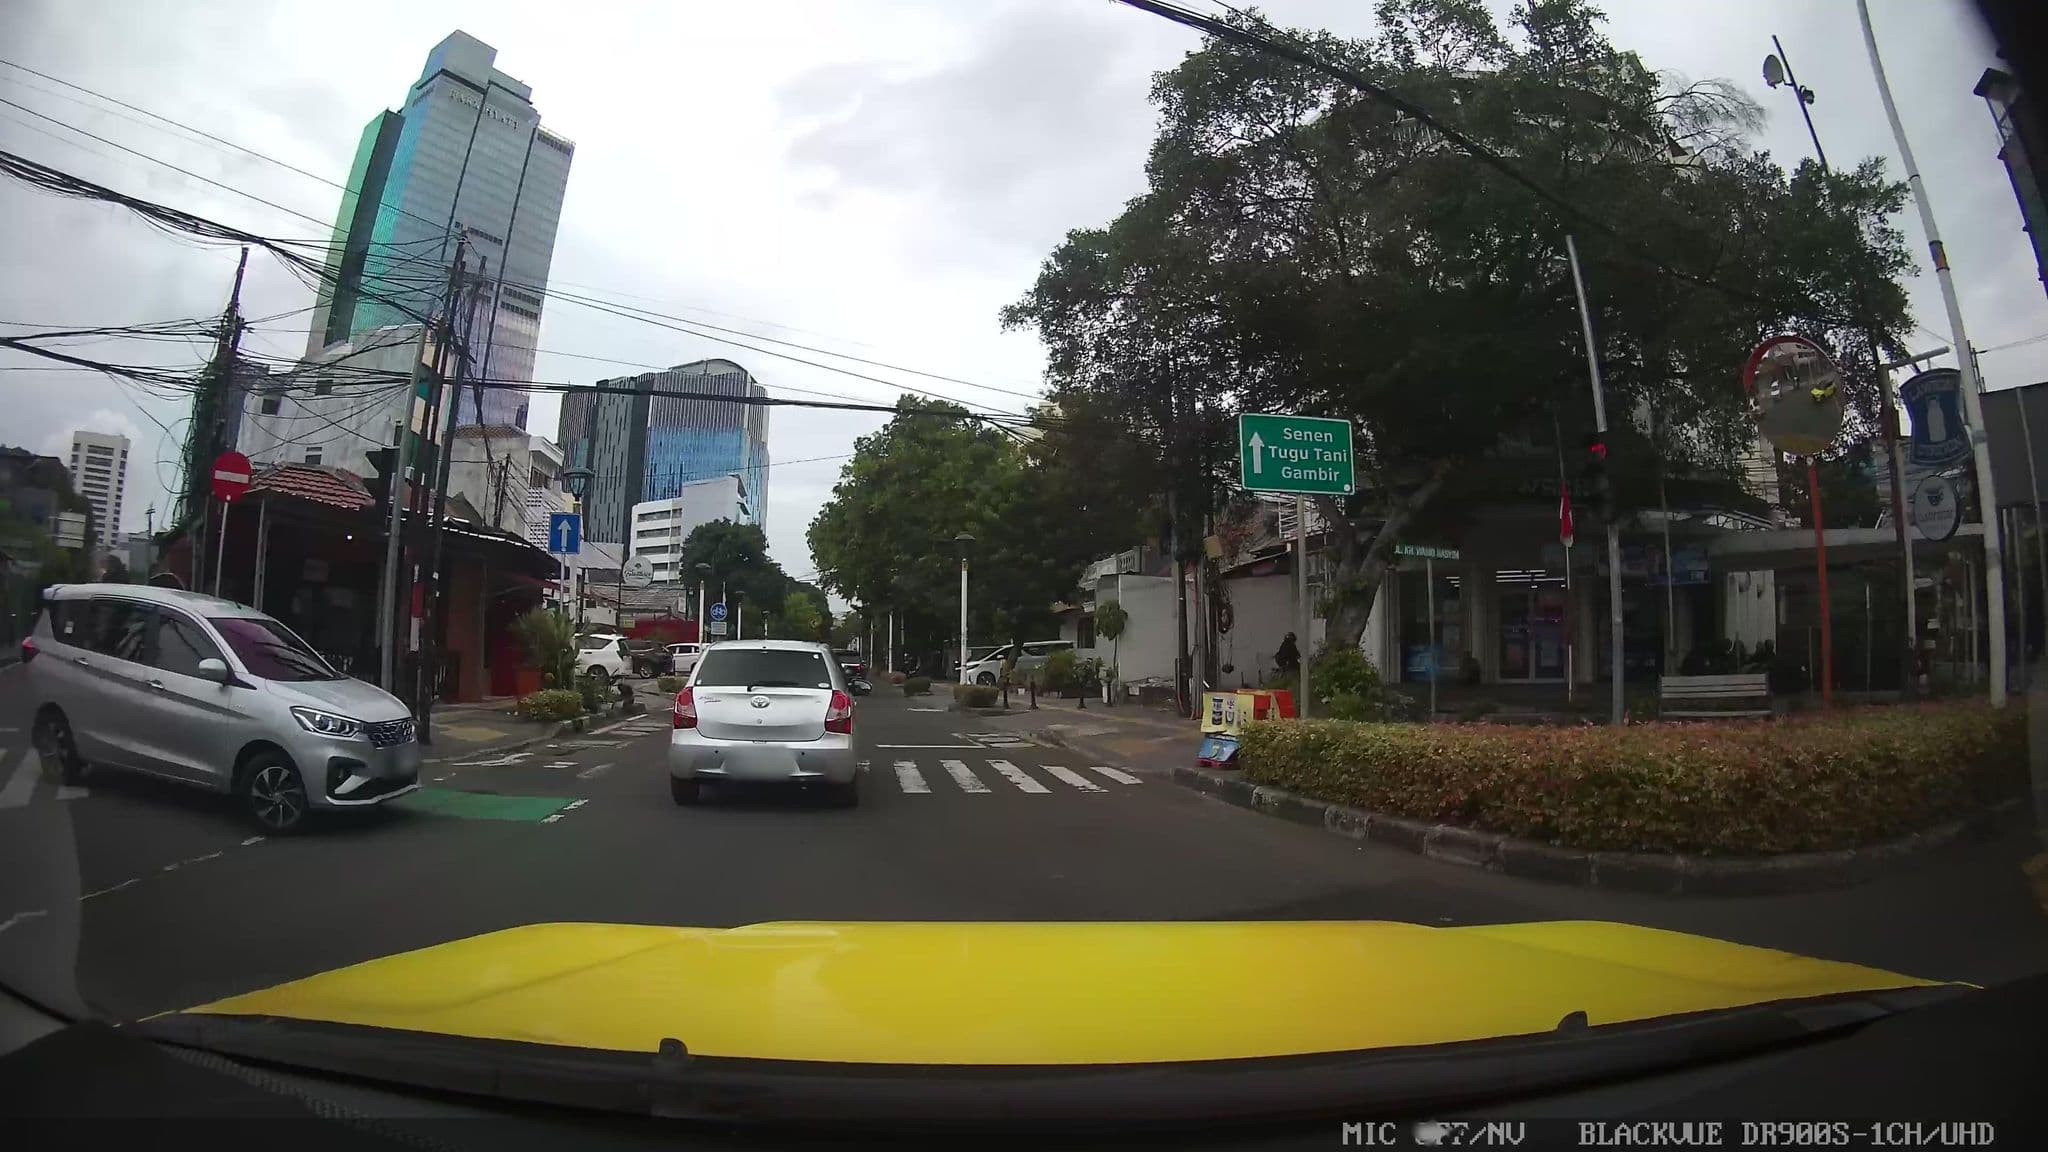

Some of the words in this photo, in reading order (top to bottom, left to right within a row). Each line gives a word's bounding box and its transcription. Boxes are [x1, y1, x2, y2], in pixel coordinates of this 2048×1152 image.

[1283, 427, 1333, 443] Senen
[1268, 445, 1308, 463] Tugu
[1314, 447, 1347, 462] Tani
[1281, 466, 1340, 482] Gambir
